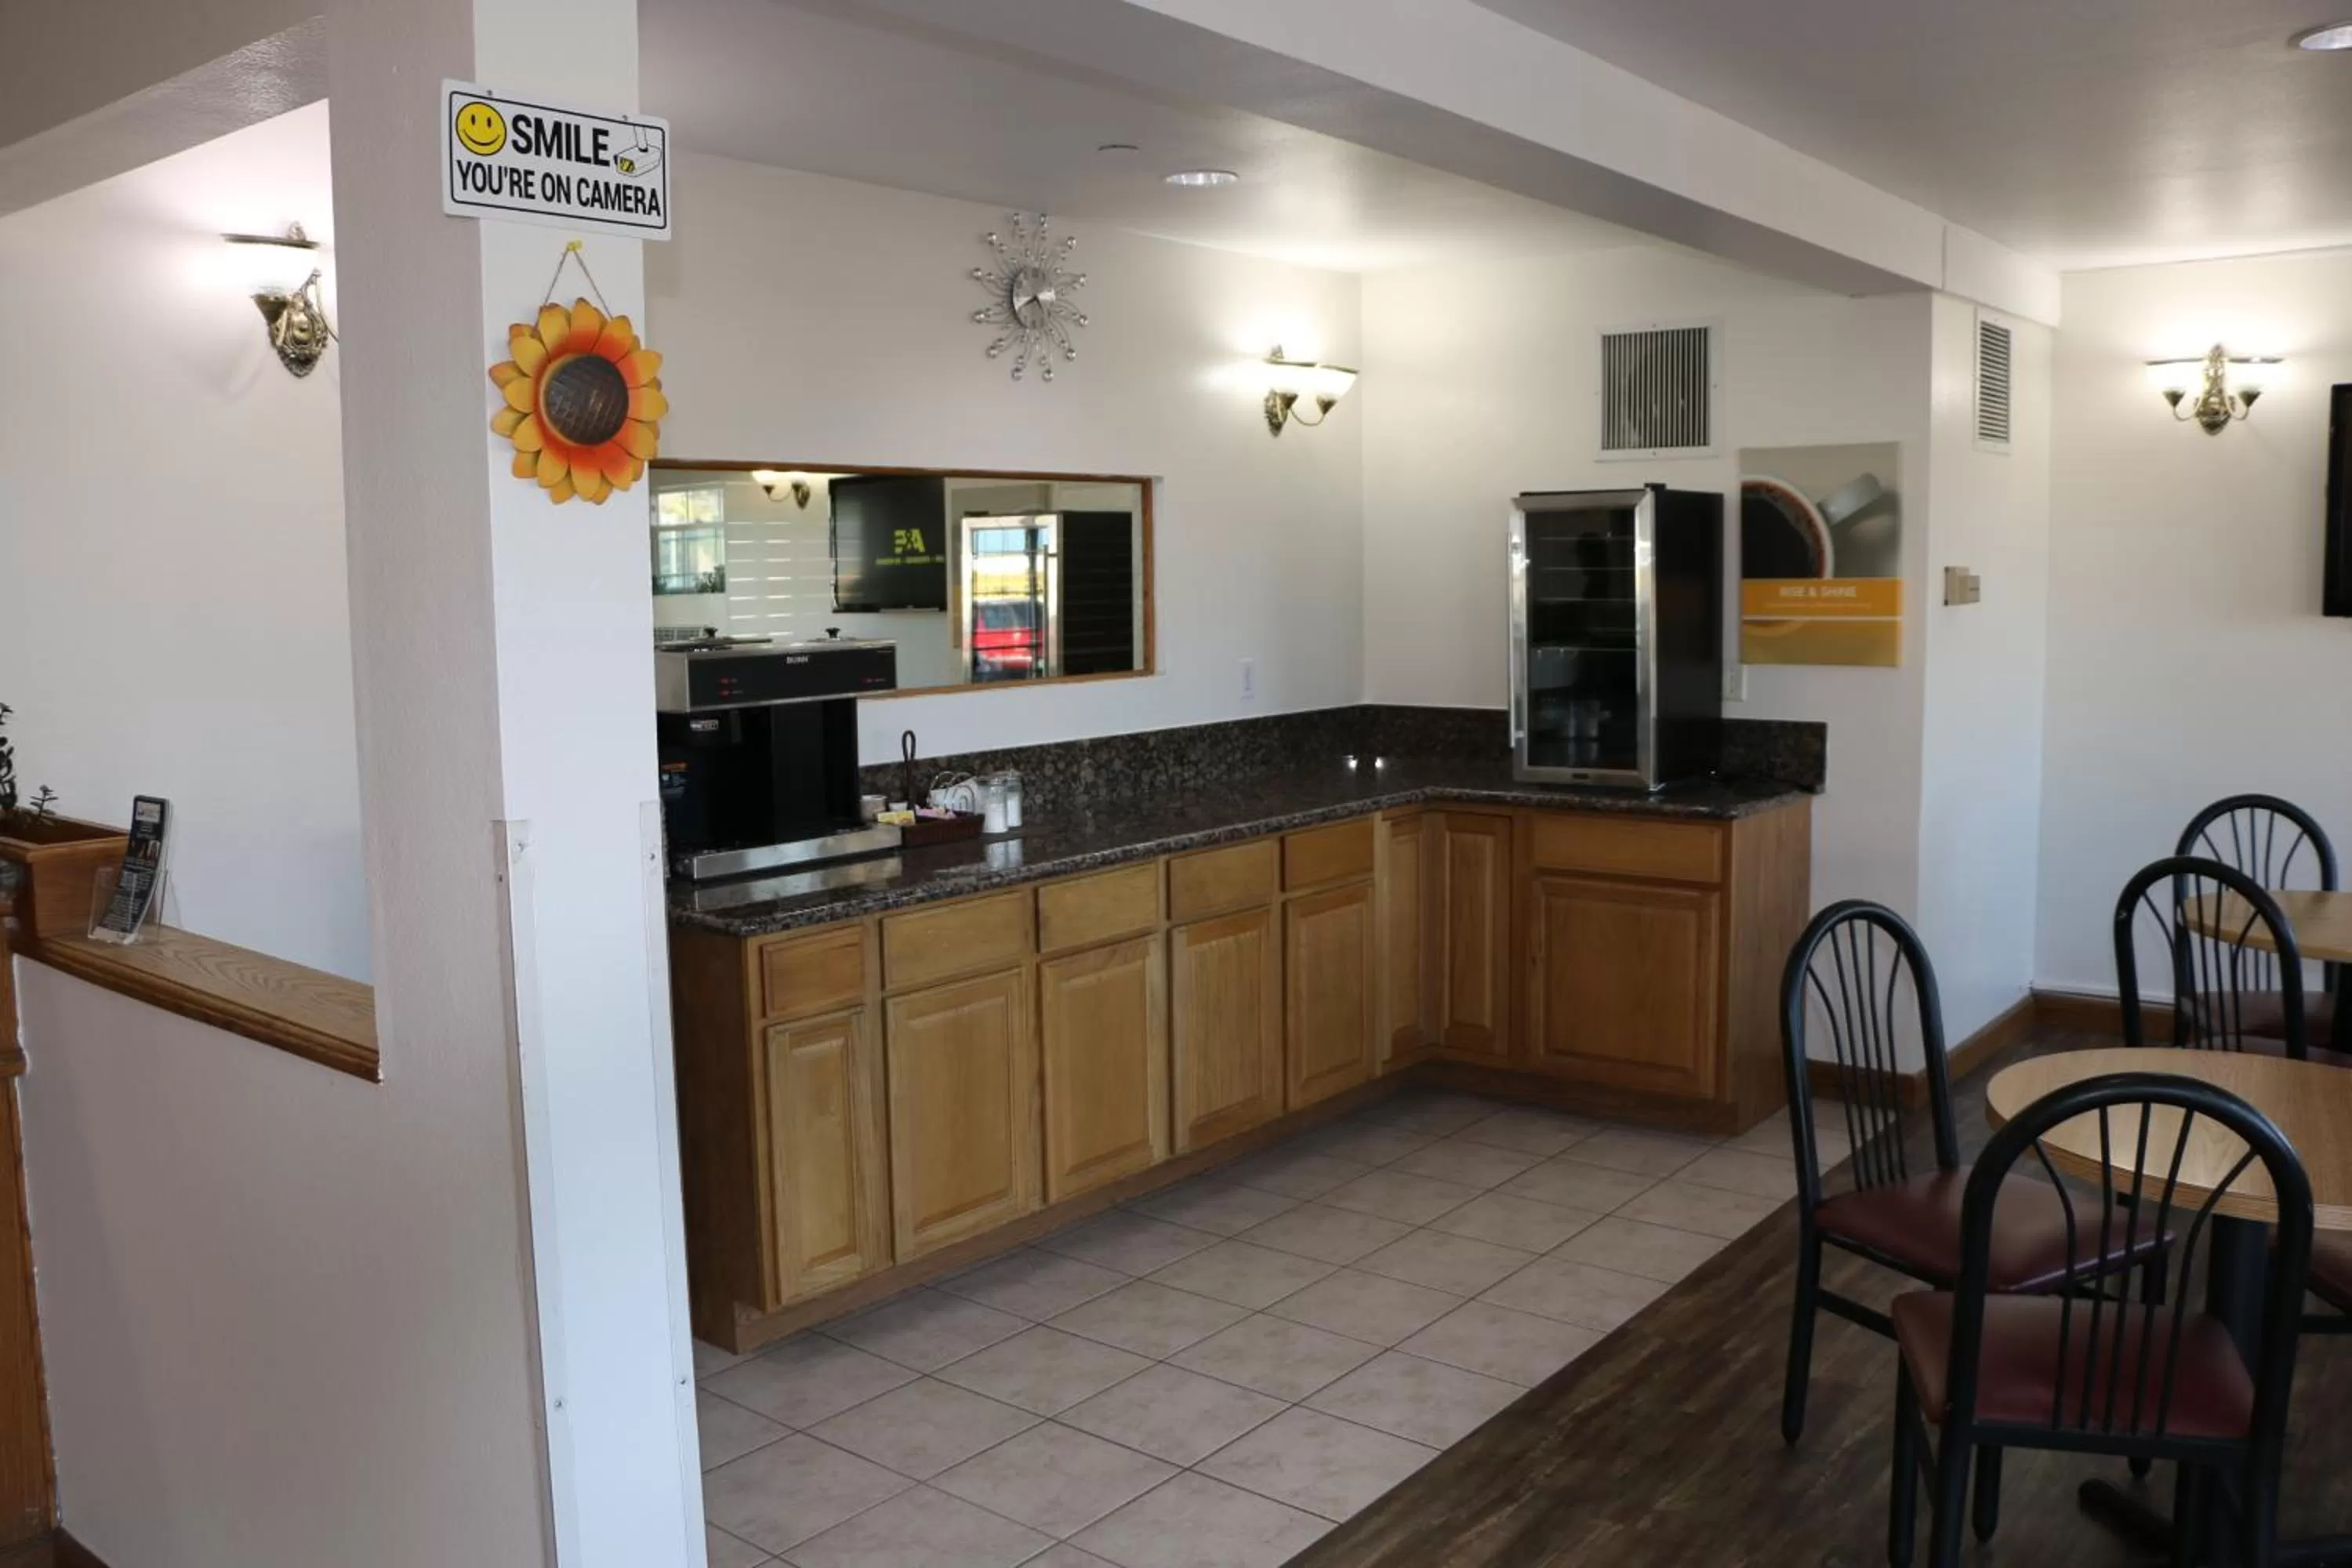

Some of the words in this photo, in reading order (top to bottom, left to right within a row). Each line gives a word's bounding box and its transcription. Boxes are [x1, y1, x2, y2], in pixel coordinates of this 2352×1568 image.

[511, 114, 610, 167] SMILE
[456, 159, 535, 200] YOU'RE
[541, 172, 572, 205] ON
[576, 177, 661, 216] CAMERA
